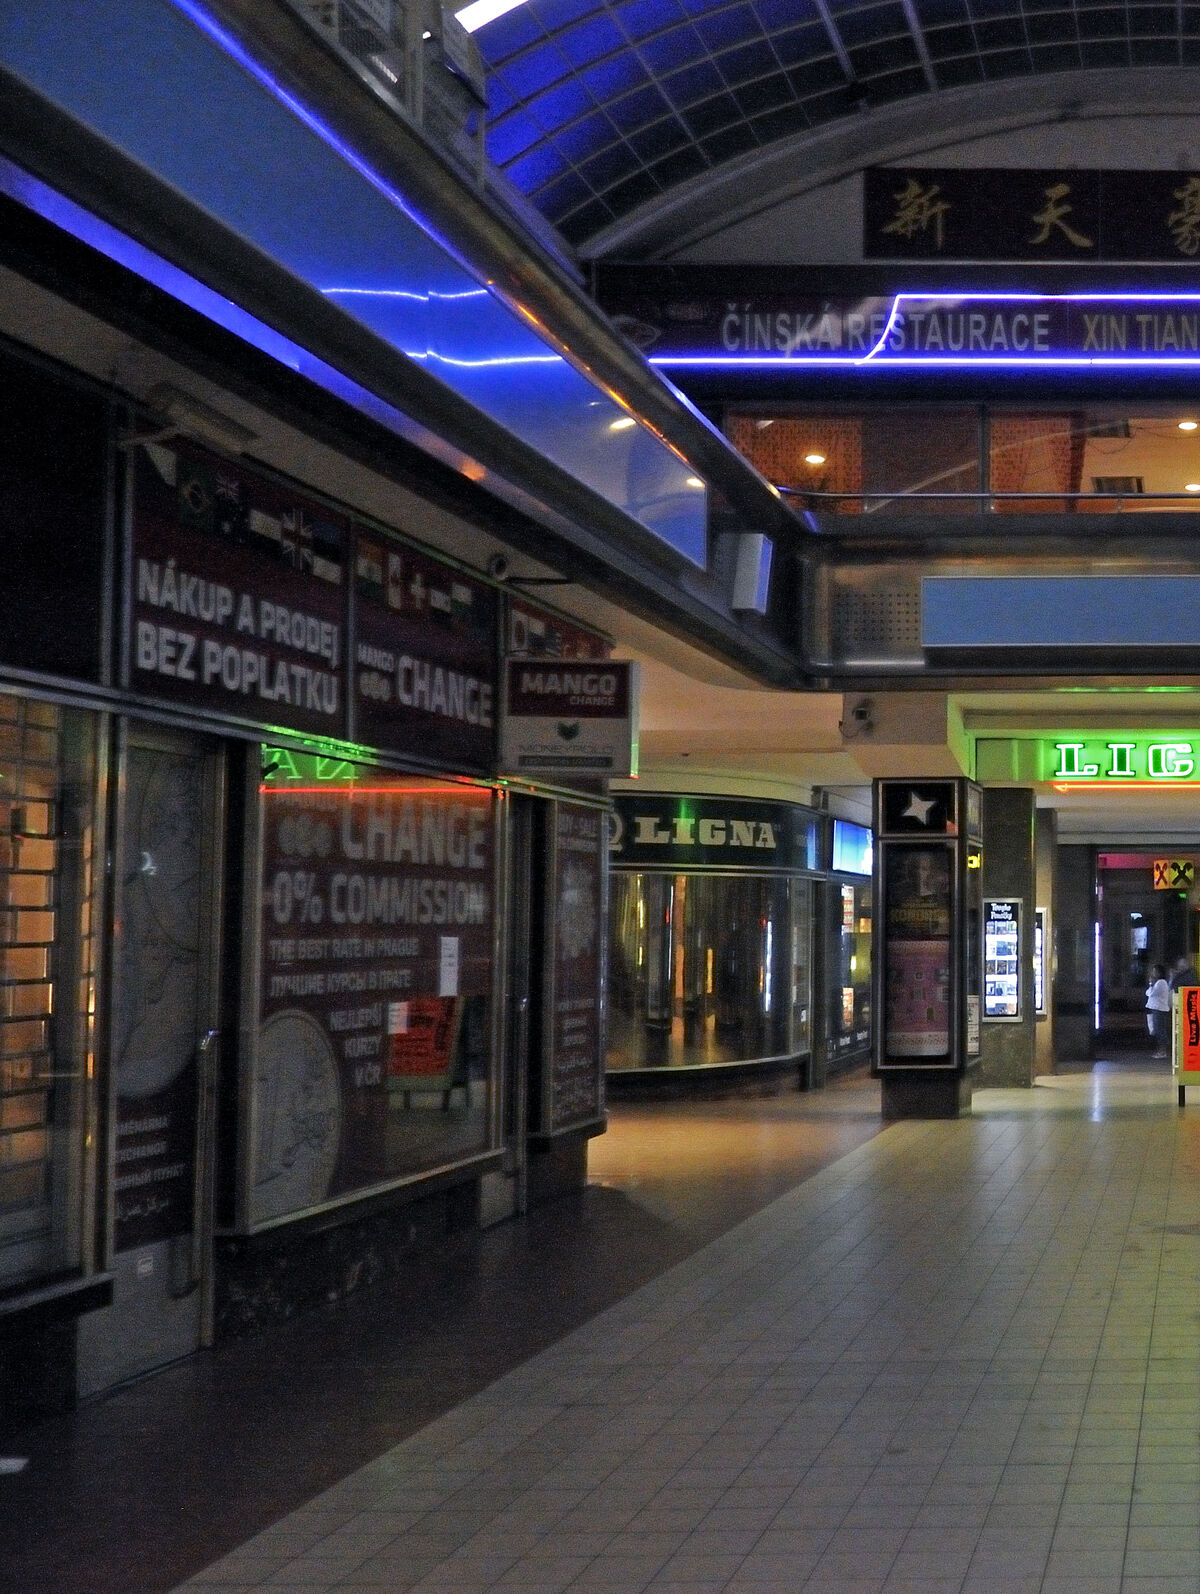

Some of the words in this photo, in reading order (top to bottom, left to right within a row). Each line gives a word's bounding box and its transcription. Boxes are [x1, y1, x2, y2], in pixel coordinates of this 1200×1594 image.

[721, 303, 841, 352] ČÍNSKÁ
[847, 312, 1050, 352] RESTAURACE
[1083, 313, 1128, 352] XIN
[1137, 313, 1199, 352] TIAN
[136, 556, 234, 629] NÁKUP
[237, 591, 256, 634] A
[260, 597, 341, 671] PRODEJ
[136, 620, 196, 682] BEZ
[203, 638, 339, 716] POPLATKU
[357, 643, 395, 673] MANGO
[398, 654, 493, 729] CHANGE
[520, 672, 618, 696] MANGO
[569, 695, 617, 707] CHANGE
[341, 792, 486, 869] CHANGE
[633, 815, 778, 849] LIGNA
[272, 869, 325, 924] 0%
[329, 872, 486, 926] COMMISSION
[270, 938, 296, 961] THE
[298, 938, 330, 960] BEST
[332, 937, 362, 959] RATE
[363, 938, 376, 957] IN
[376, 937, 420, 957] PRAGUE
